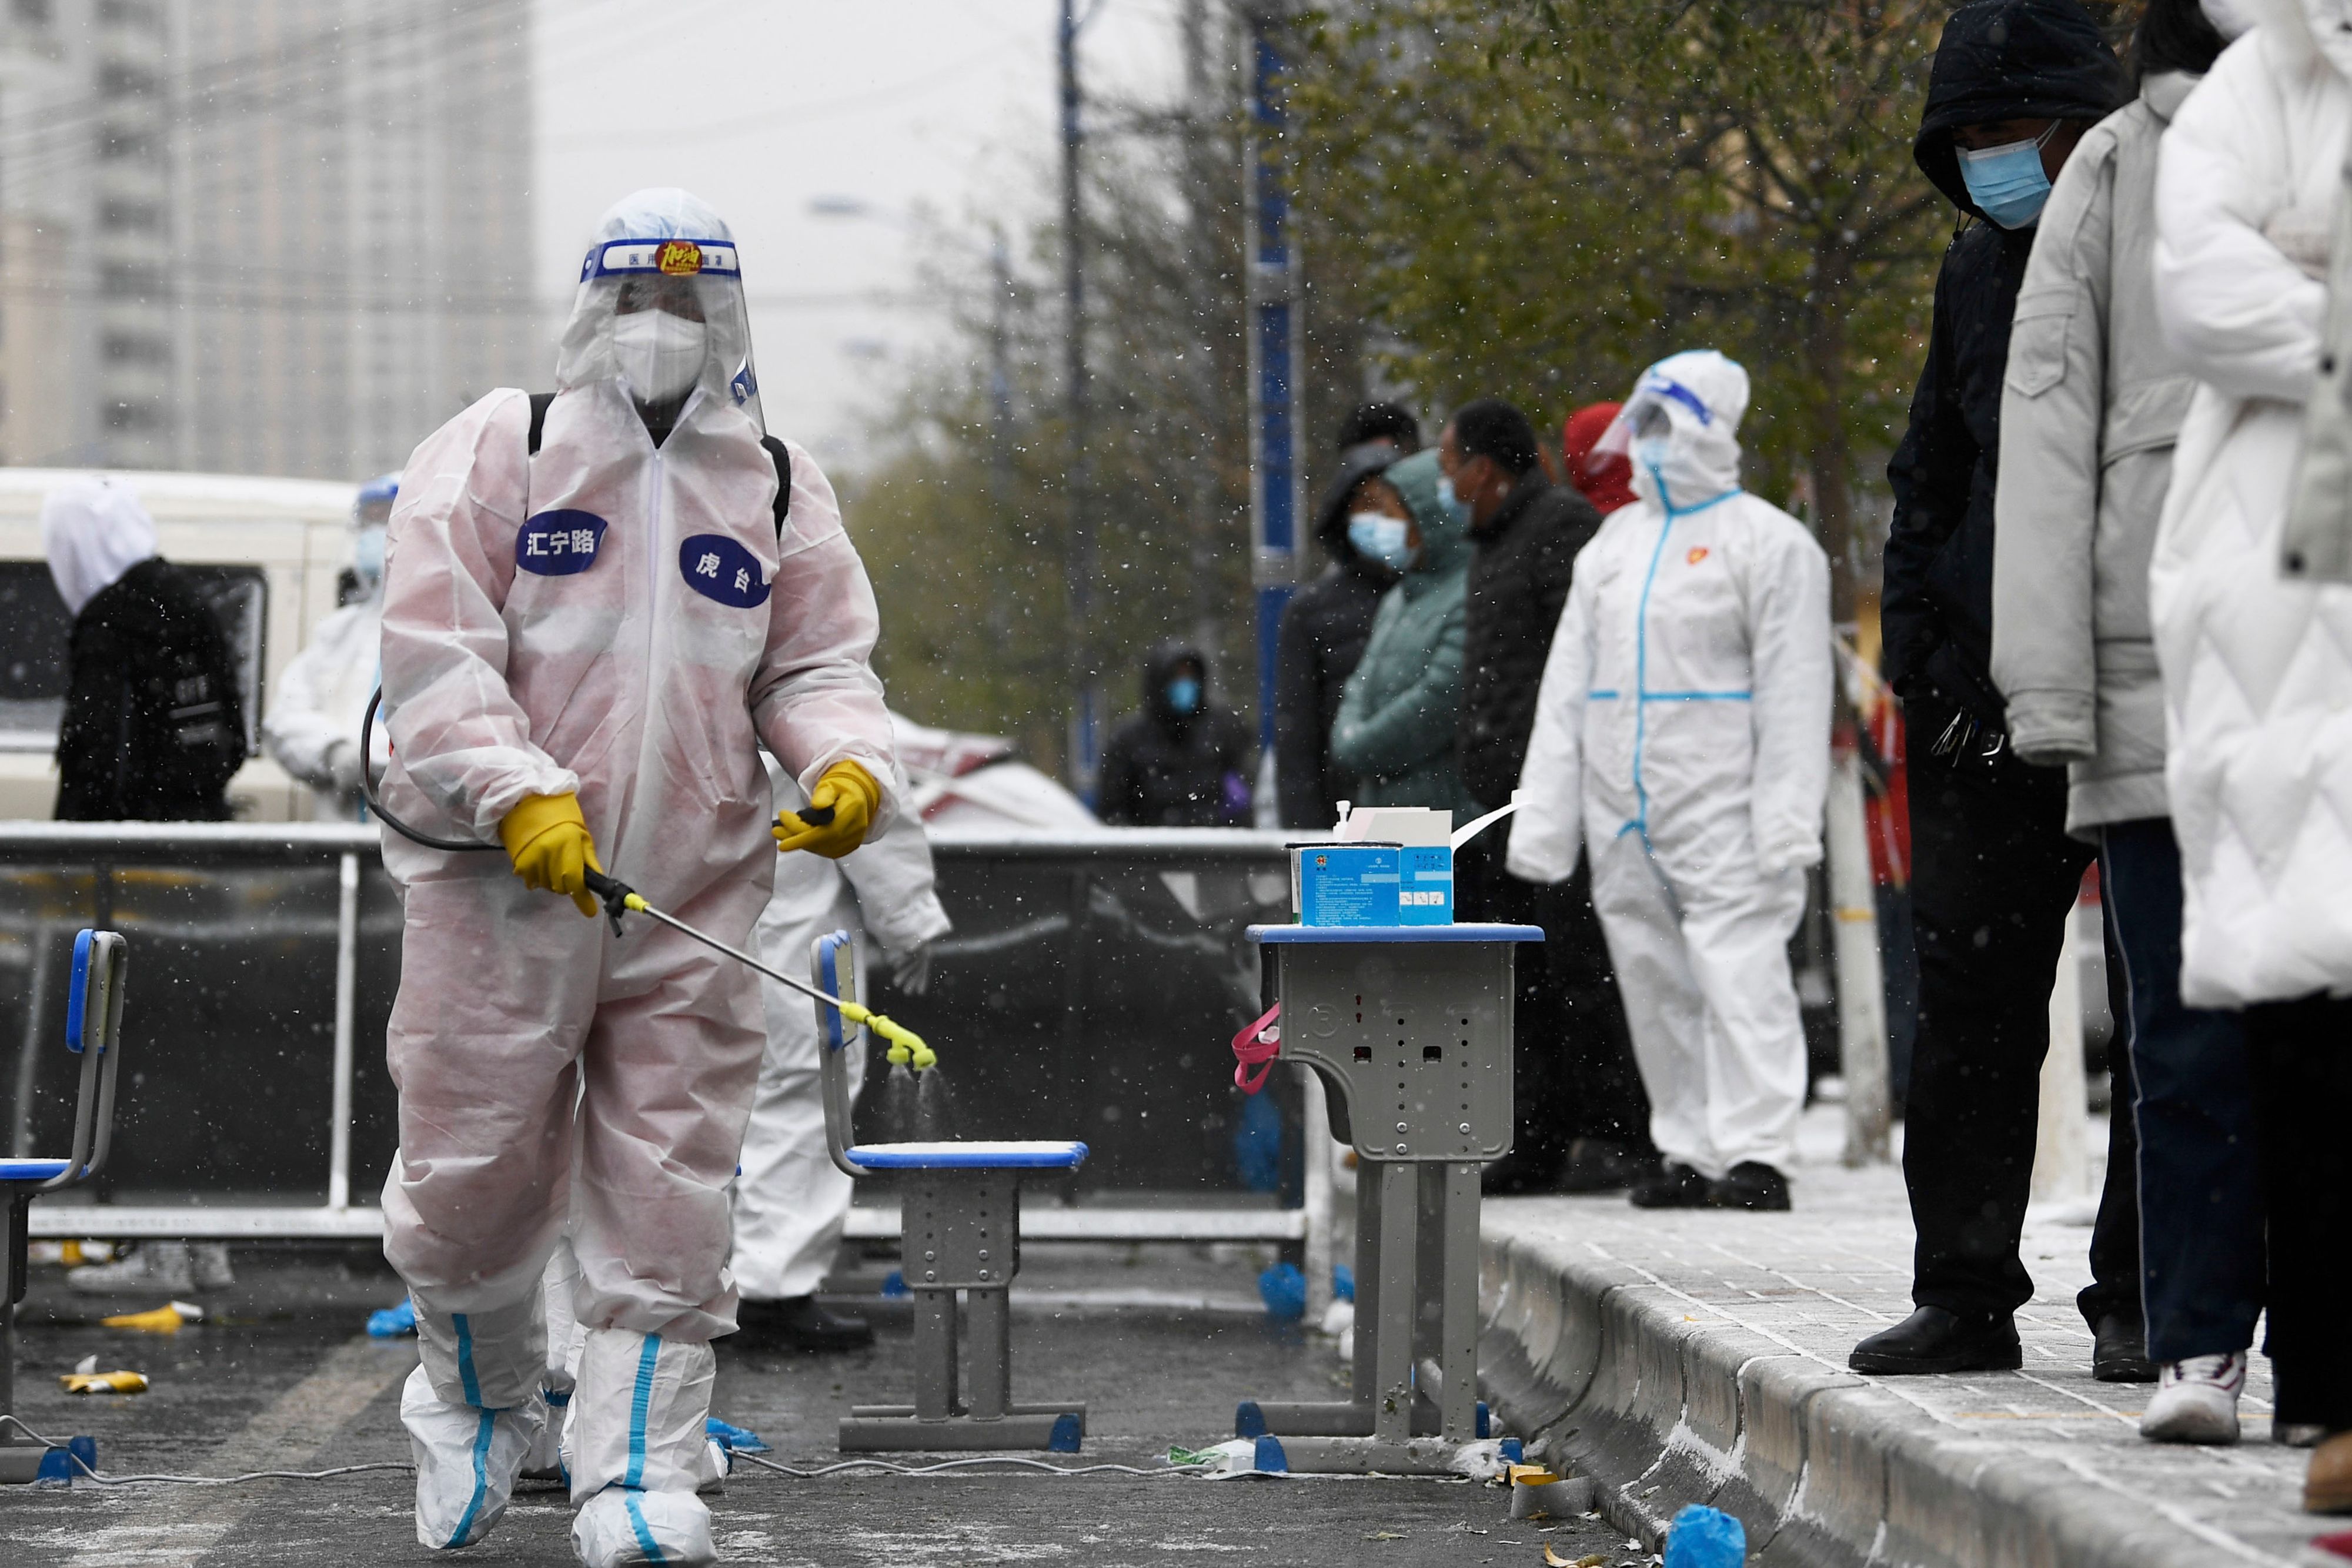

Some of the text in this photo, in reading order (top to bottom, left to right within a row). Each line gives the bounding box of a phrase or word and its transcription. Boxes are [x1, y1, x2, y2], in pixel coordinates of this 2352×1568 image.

[526, 529, 594, 556] 汇宁路
[696, 552, 750, 593] 虎台
